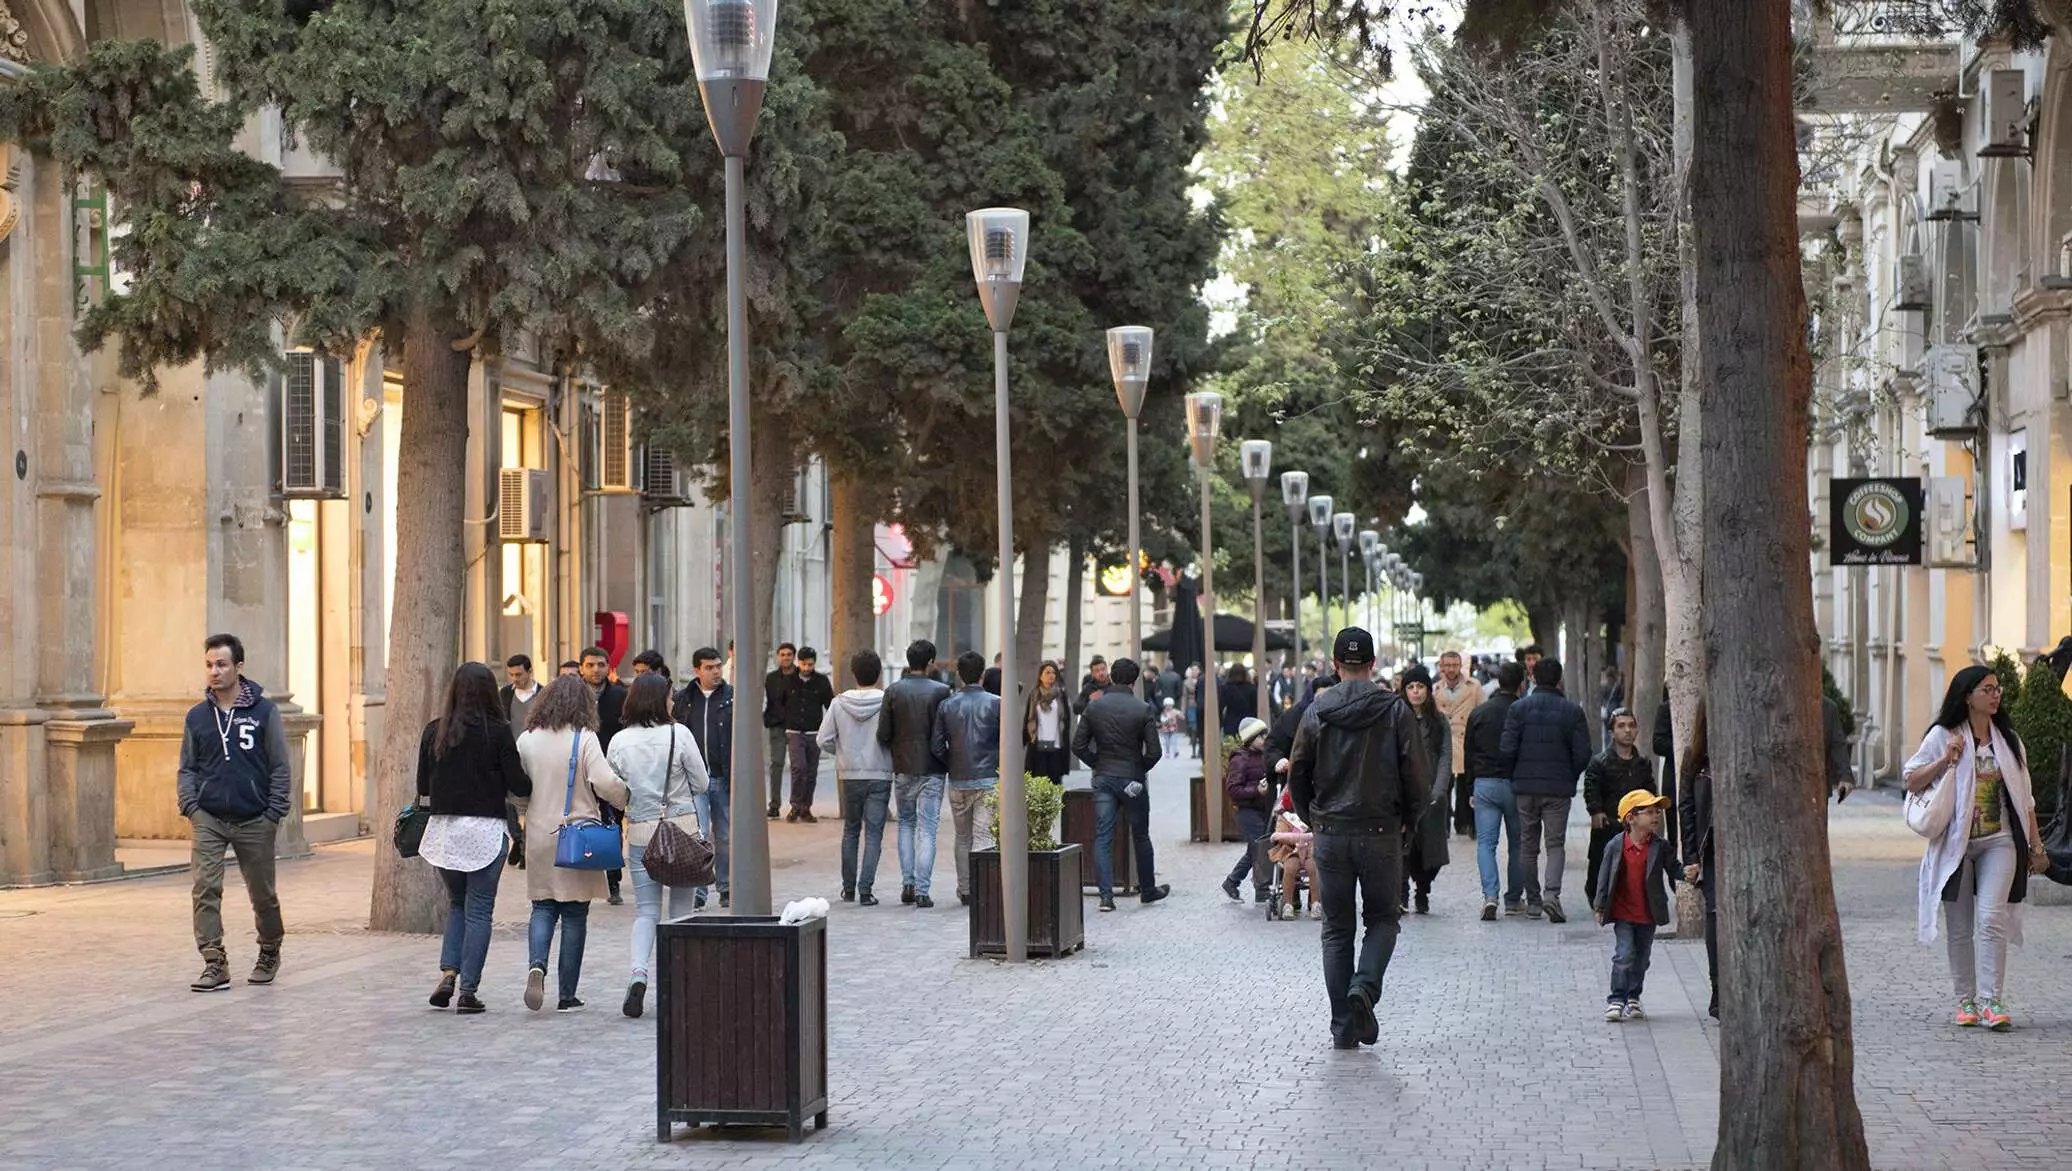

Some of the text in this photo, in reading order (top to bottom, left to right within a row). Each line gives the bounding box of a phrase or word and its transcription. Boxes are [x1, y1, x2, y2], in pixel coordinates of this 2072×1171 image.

[1849, 482, 1904, 506] COFFEESHOP
[1854, 528, 1899, 545] COMPANY
[239, 724, 256, 750] 5
